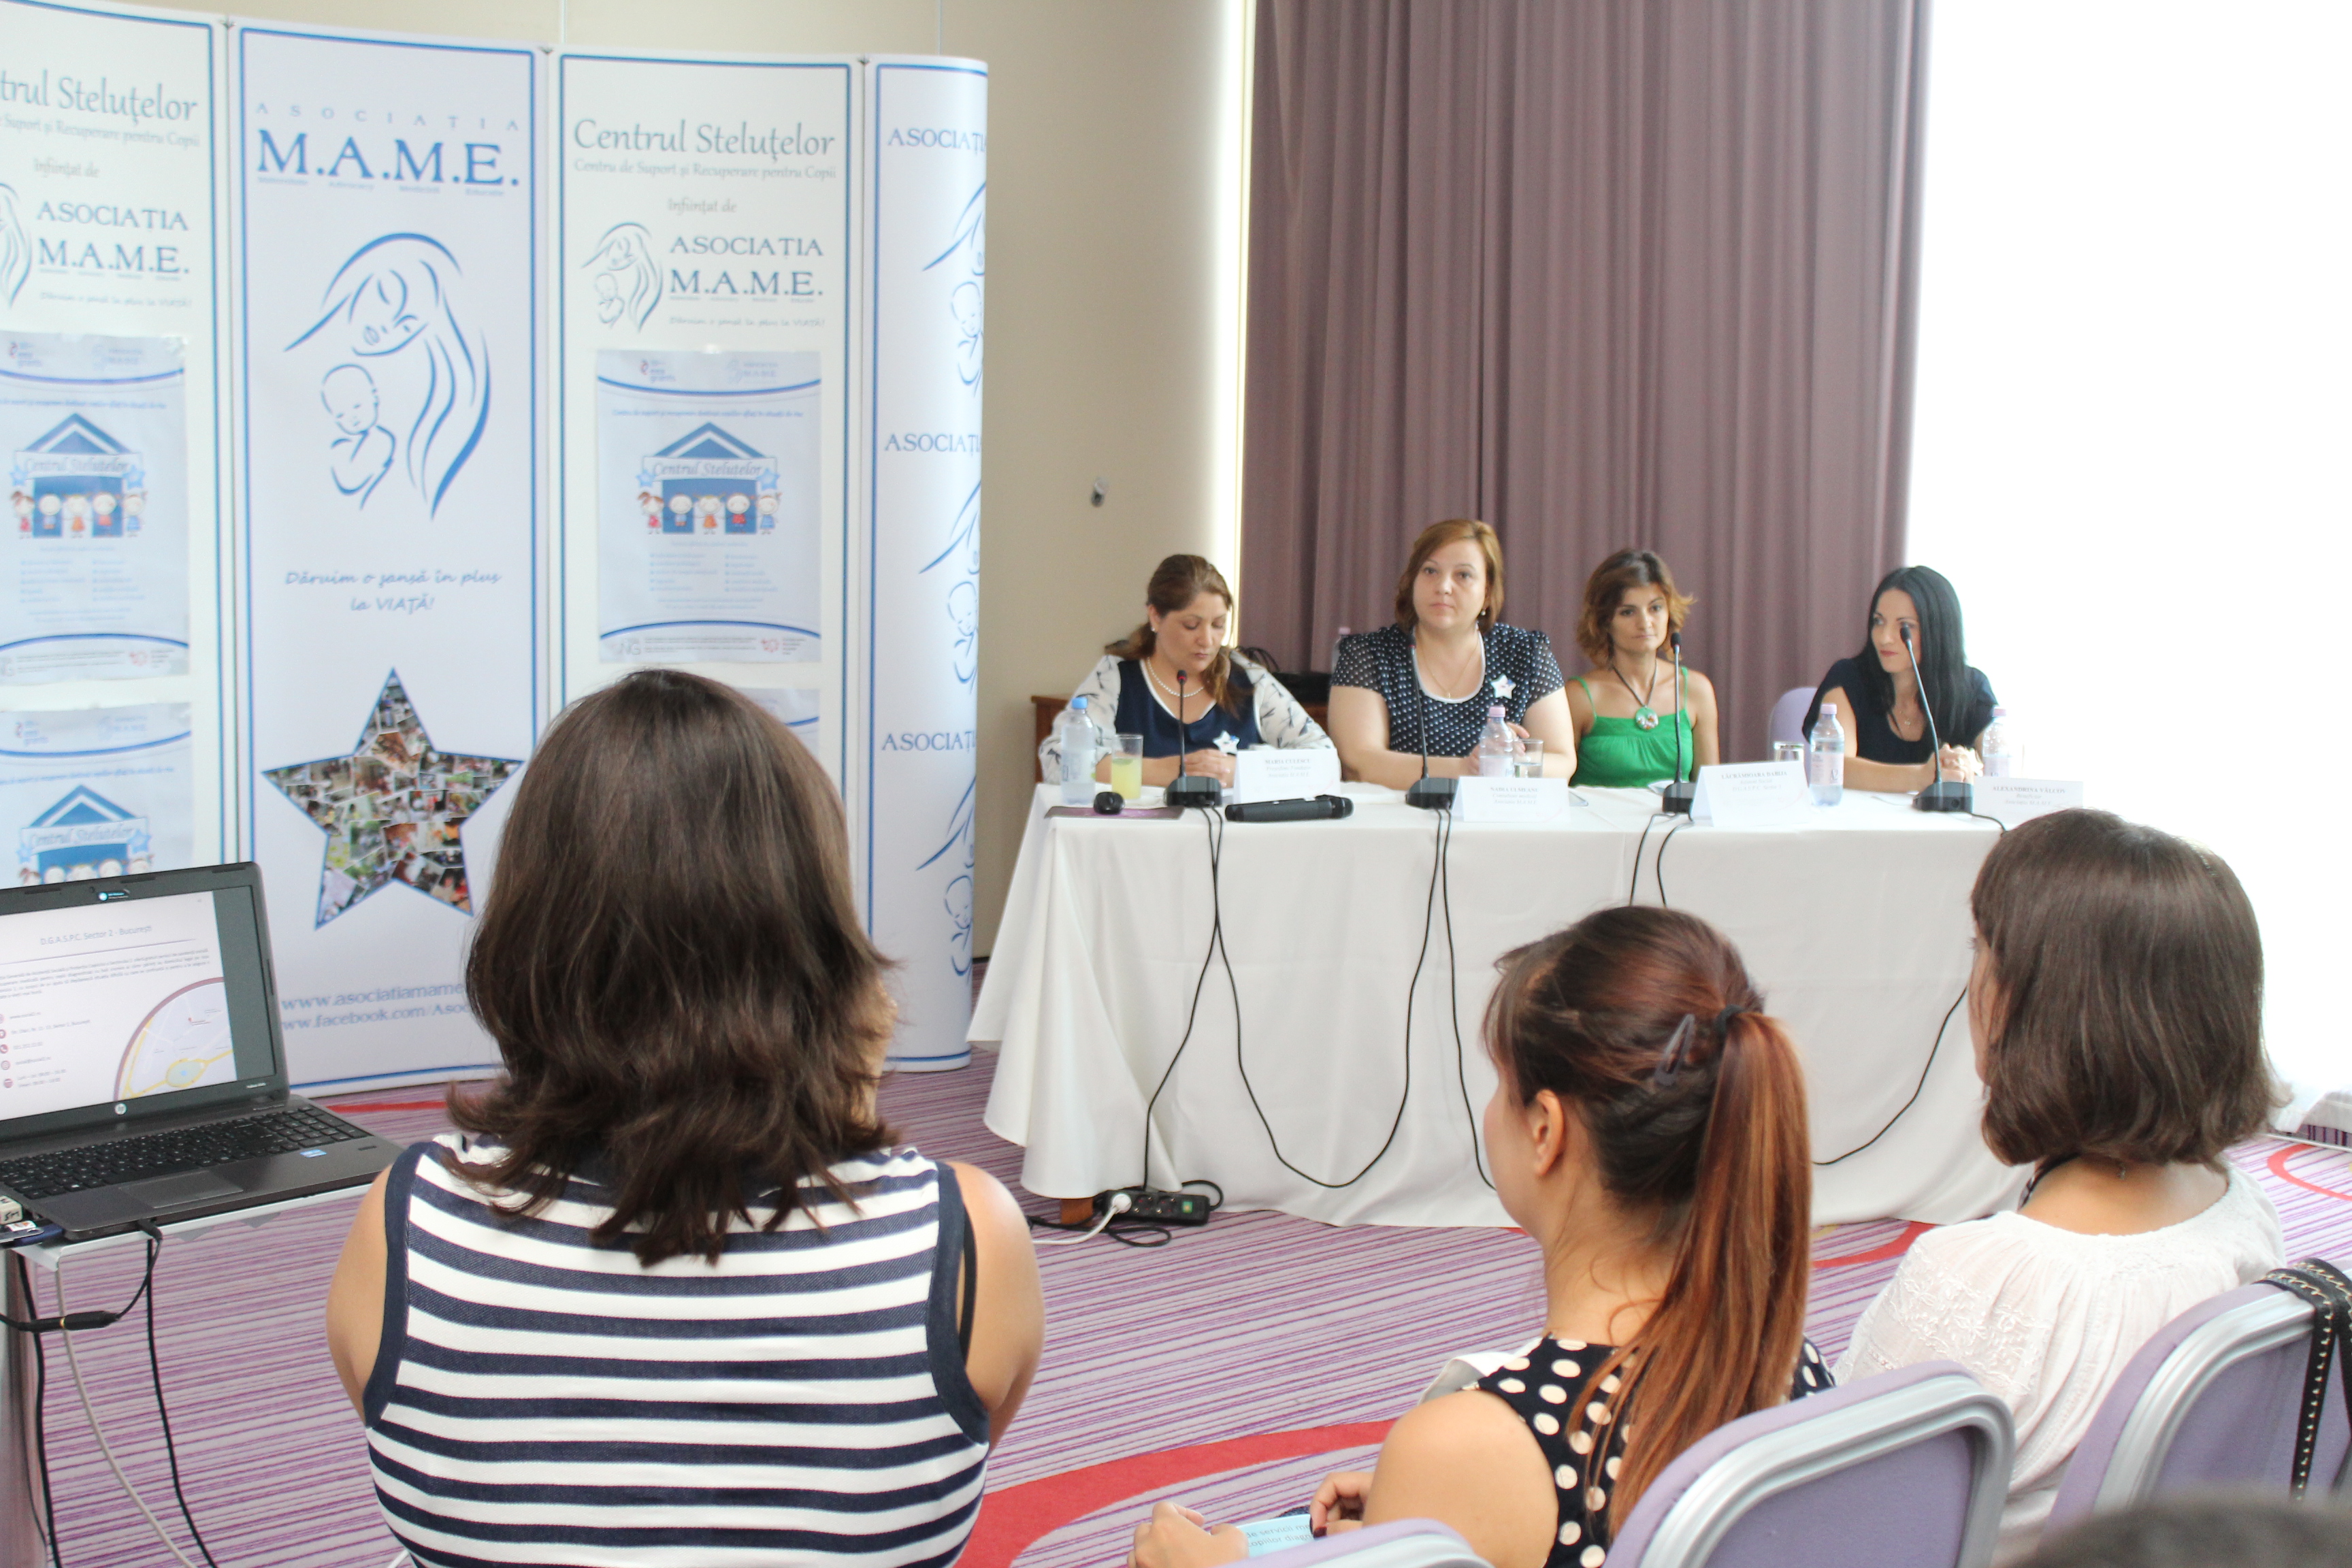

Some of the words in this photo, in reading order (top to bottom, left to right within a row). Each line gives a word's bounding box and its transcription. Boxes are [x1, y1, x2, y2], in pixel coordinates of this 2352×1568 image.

[574, 118, 687, 152] Centrul
[257, 128, 519, 186] M.A.M.E.
[620, 159, 635, 174] de
[637, 161, 676, 180] Suport
[761, 165, 802, 180] pentru
[720, 197, 737, 213] de
[39, 238, 190, 274] M.A.M.E.
[670, 269, 823, 296] M.A.M.E.
[284, 570, 359, 585] Dăruim
[363, 574, 375, 584] o
[350, 597, 371, 611] la
[84, 930, 107, 940] Sector
[108, 929, 114, 938] 2
[1260, 1525, 1293, 1535] servicii
